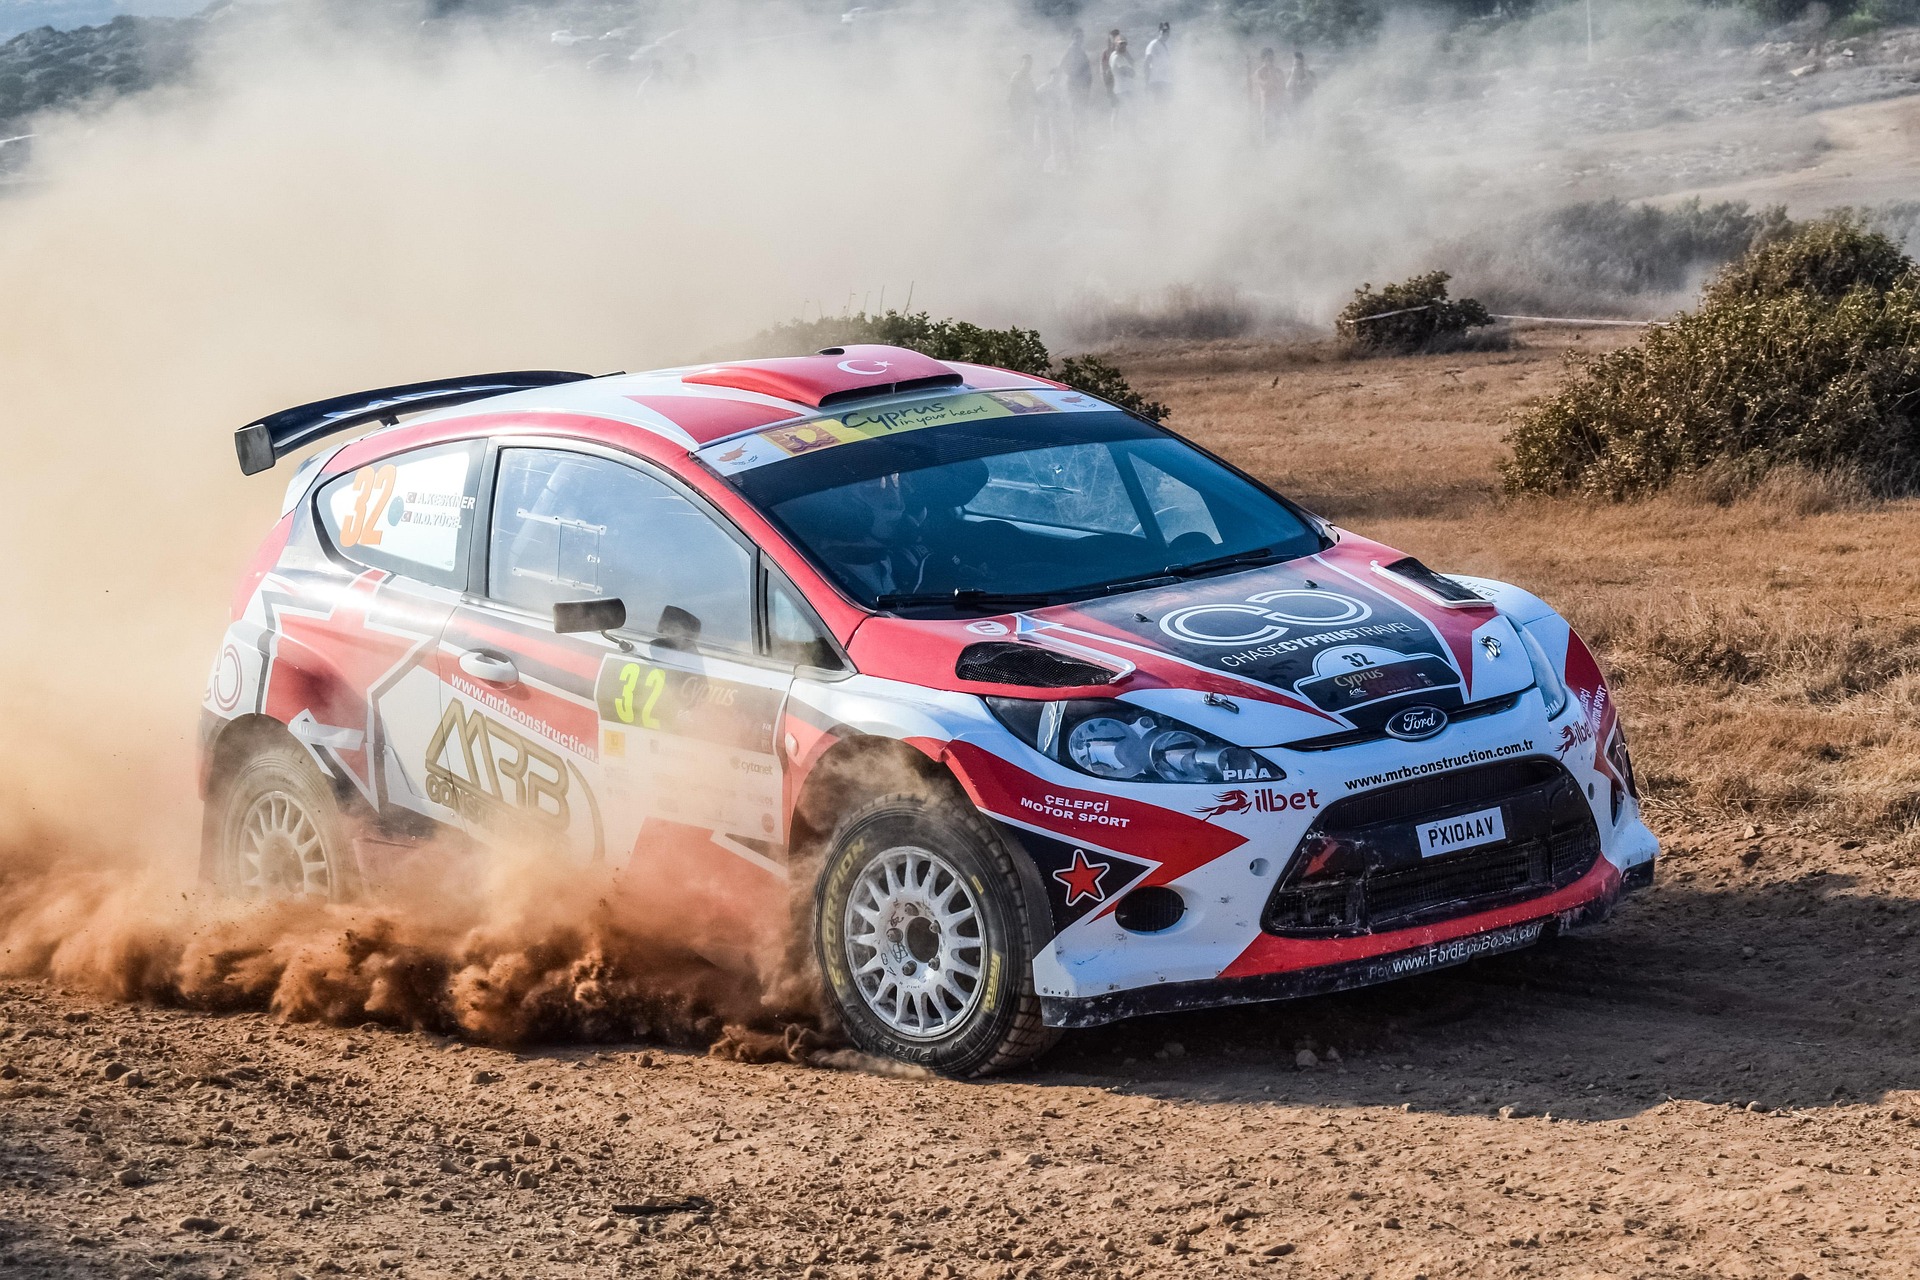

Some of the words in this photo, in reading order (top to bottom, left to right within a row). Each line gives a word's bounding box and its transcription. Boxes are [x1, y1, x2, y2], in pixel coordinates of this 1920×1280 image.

[841, 401, 946, 431] Cyprus
[899, 417, 914, 427] in
[915, 413, 947, 429] your
[949, 405, 988, 419] heart
[340, 464, 396, 547] 32
[1220, 621, 1420, 668] CHASECYPRUSTRAVEL
[1342, 653, 1375, 667] 32
[1334, 669, 1384, 688] Cyprus
[615, 663, 666, 730] 32
[1403, 711, 1436, 732] Ford
[425, 697, 570, 832] MRB
[741, 760, 773, 775] cytanet
[1223, 767, 1272, 781] PIAA
[1344, 739, 1534, 790] www.mrbconstruction.com.tr
[1020, 797, 1074, 820] MOTOR
[1078, 811, 1130, 828] SPORT
[1044, 794, 1110, 813] ÇELEPÇİ
[1255, 788, 1320, 813] ilbet
[1428, 816, 1493, 848] PX10AAV
[826, 837, 865, 987] SCORPION
